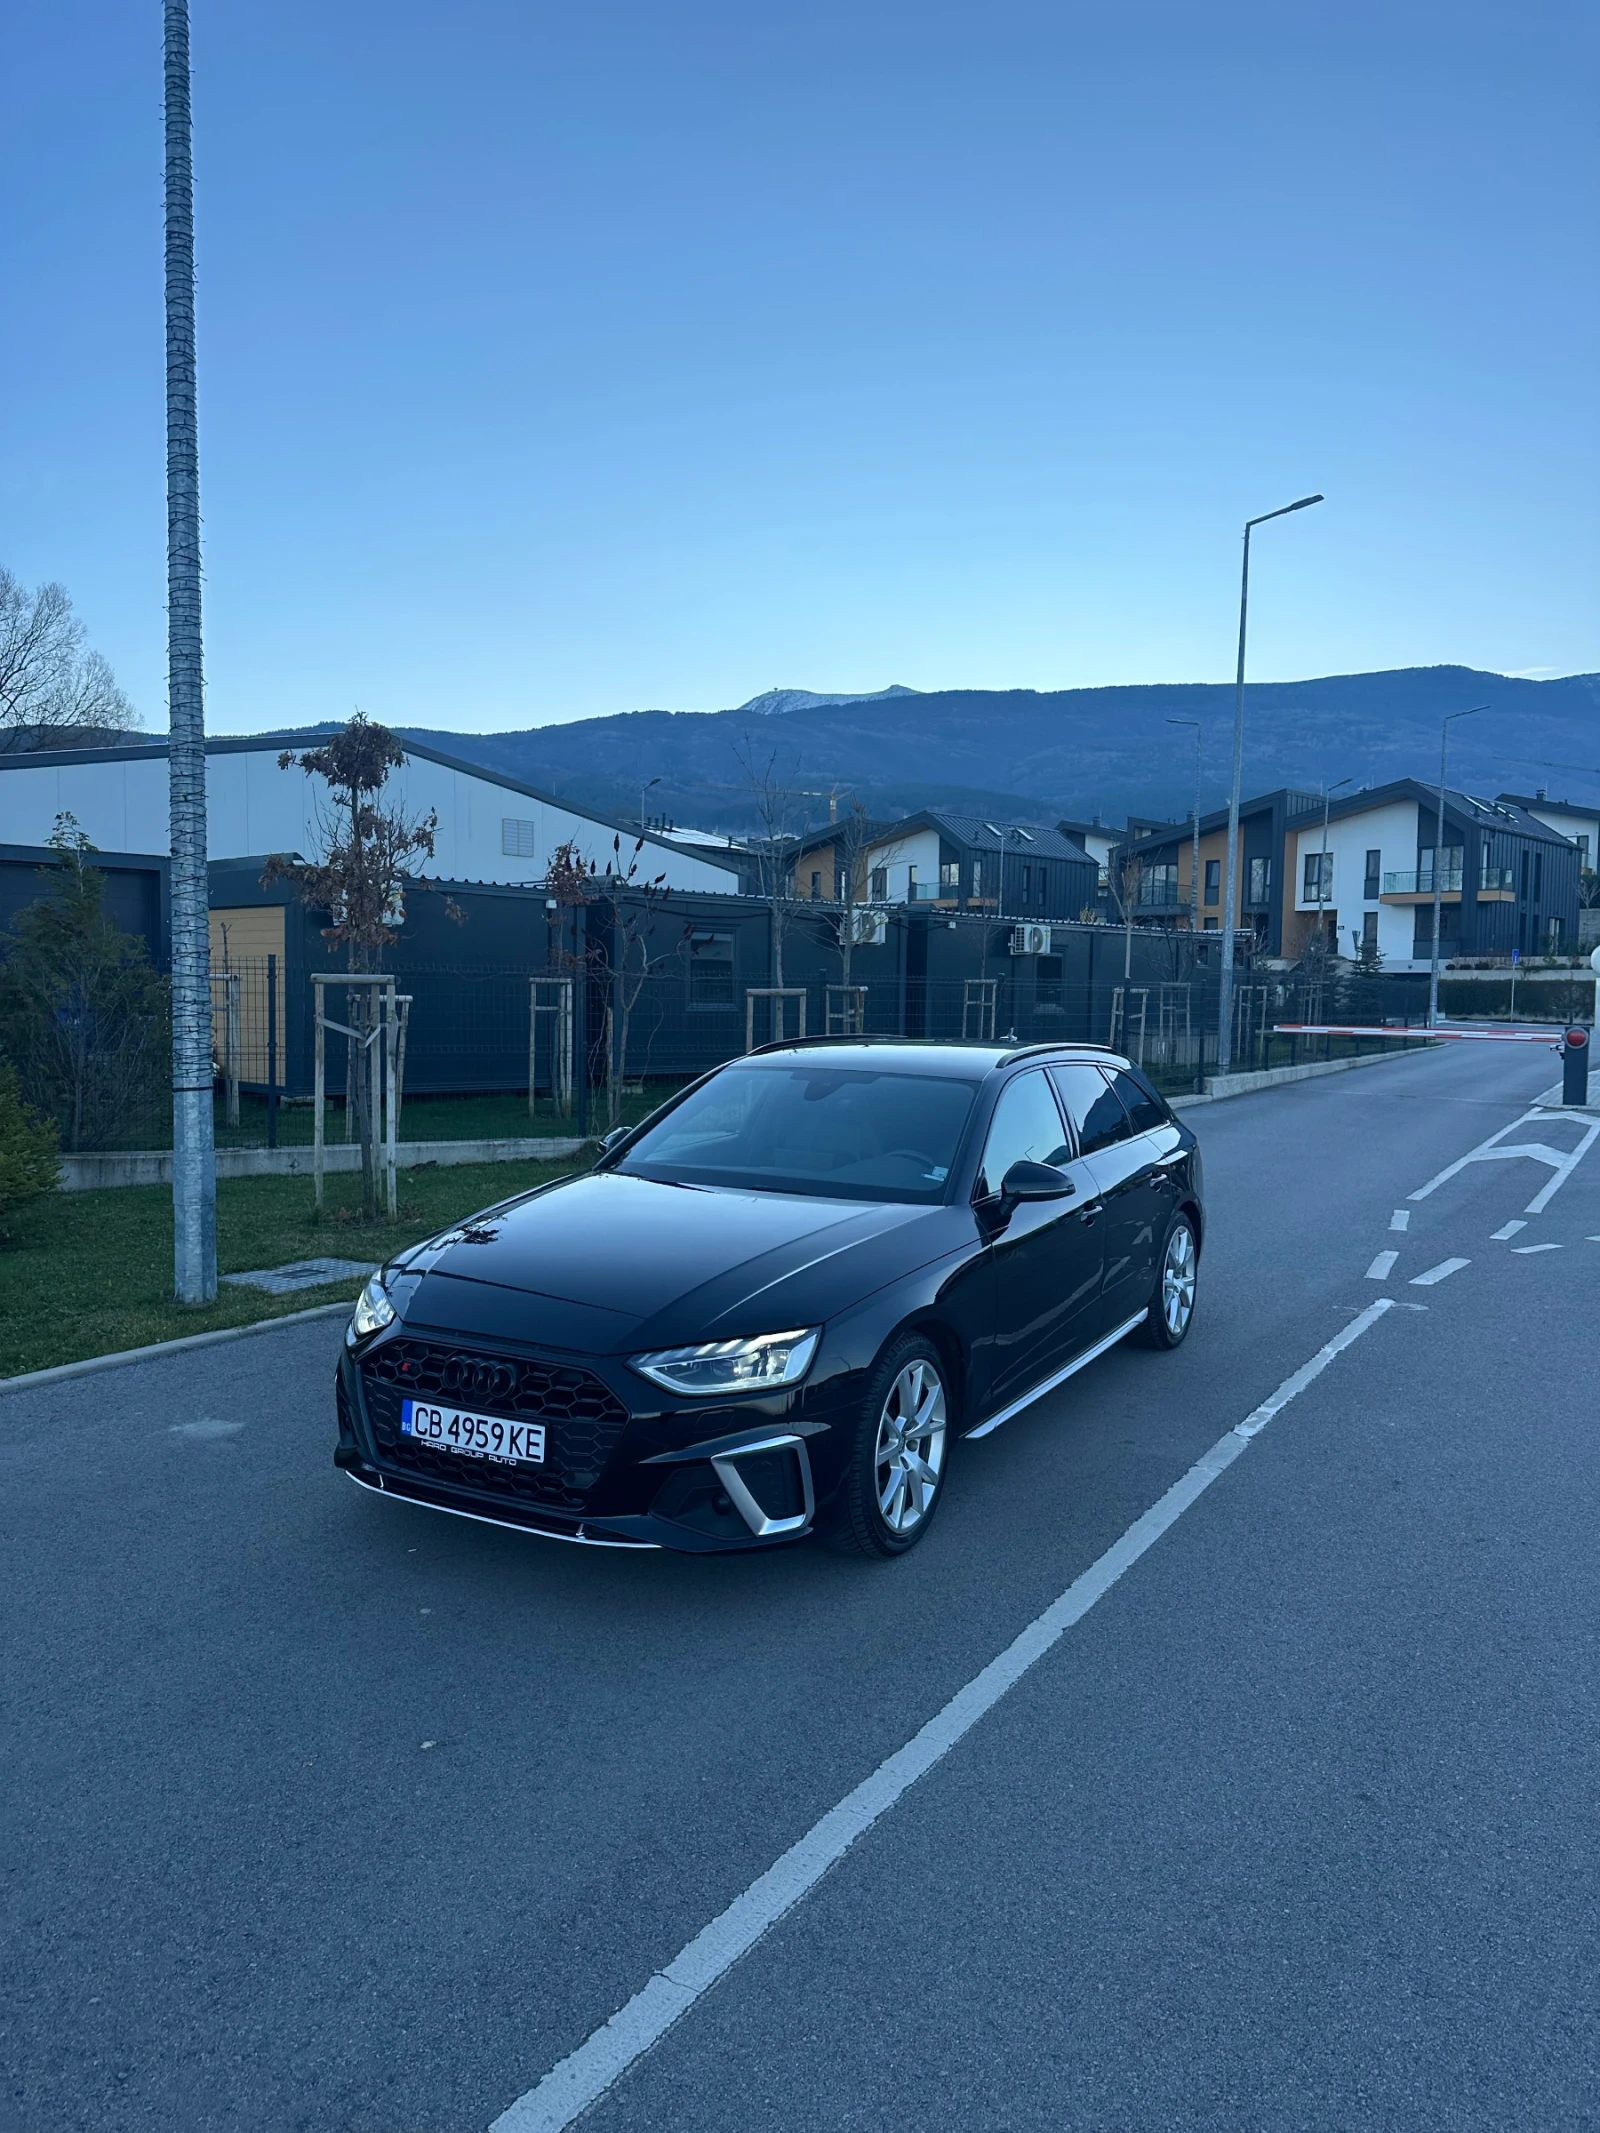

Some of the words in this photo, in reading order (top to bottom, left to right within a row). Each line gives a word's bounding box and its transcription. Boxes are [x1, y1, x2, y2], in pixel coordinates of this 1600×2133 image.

[401, 1421, 411, 1432] BG
[415, 1407, 442, 1438] CB
[448, 1414, 504, 1452] 4959
[509, 1425, 542, 1460] KE
[450, 1447, 484, 1459] GROUP
[488, 1454, 517, 1466] AUTO
